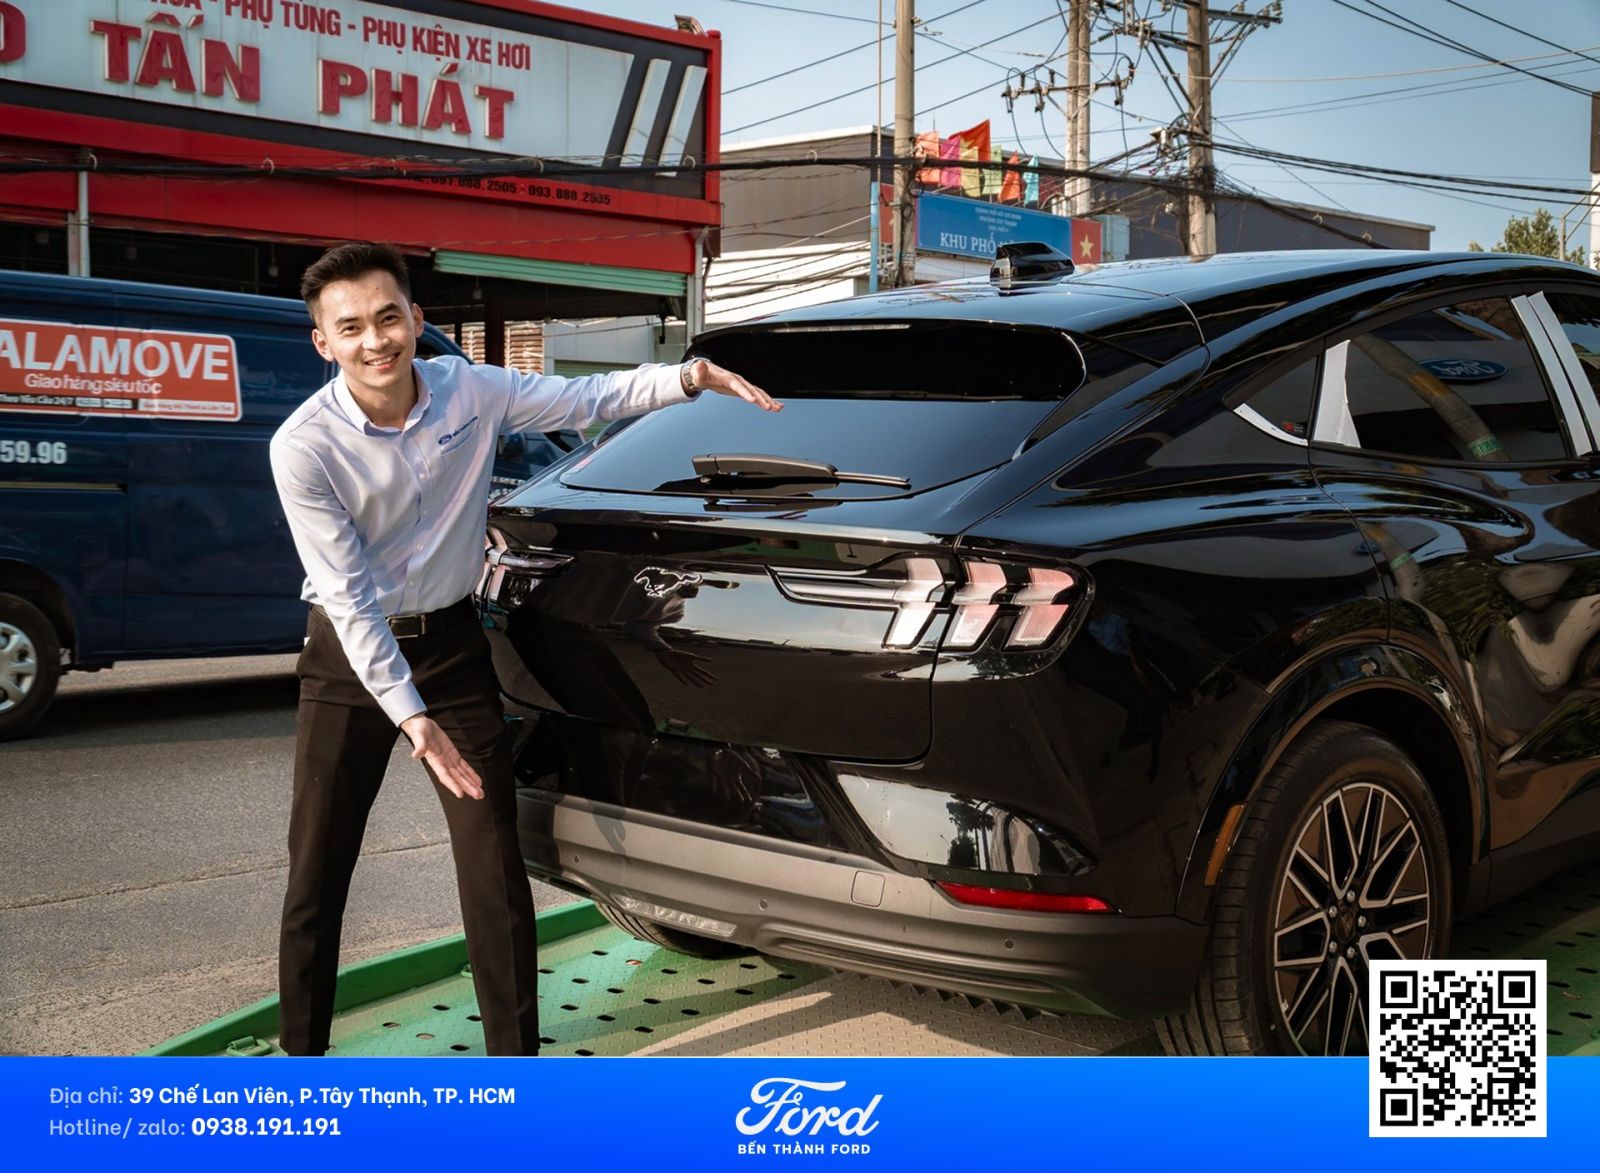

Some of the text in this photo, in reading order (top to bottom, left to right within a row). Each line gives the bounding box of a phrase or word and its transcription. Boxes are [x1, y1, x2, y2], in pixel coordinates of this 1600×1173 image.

[225, 0, 273, 28] PHỤ
[363, 16, 406, 55] PHỤ
[412, 24, 461, 62] KIỆN
[466, 35, 492, 64] XE
[497, 41, 532, 71] HƠI
[90, 11, 261, 103] TẤN
[318, 58, 515, 140] PHÁT
[940, 232, 968, 249] KHU
[971, 232, 996, 254] PHỐ
[0, 329, 229, 381] ALAMOVE
